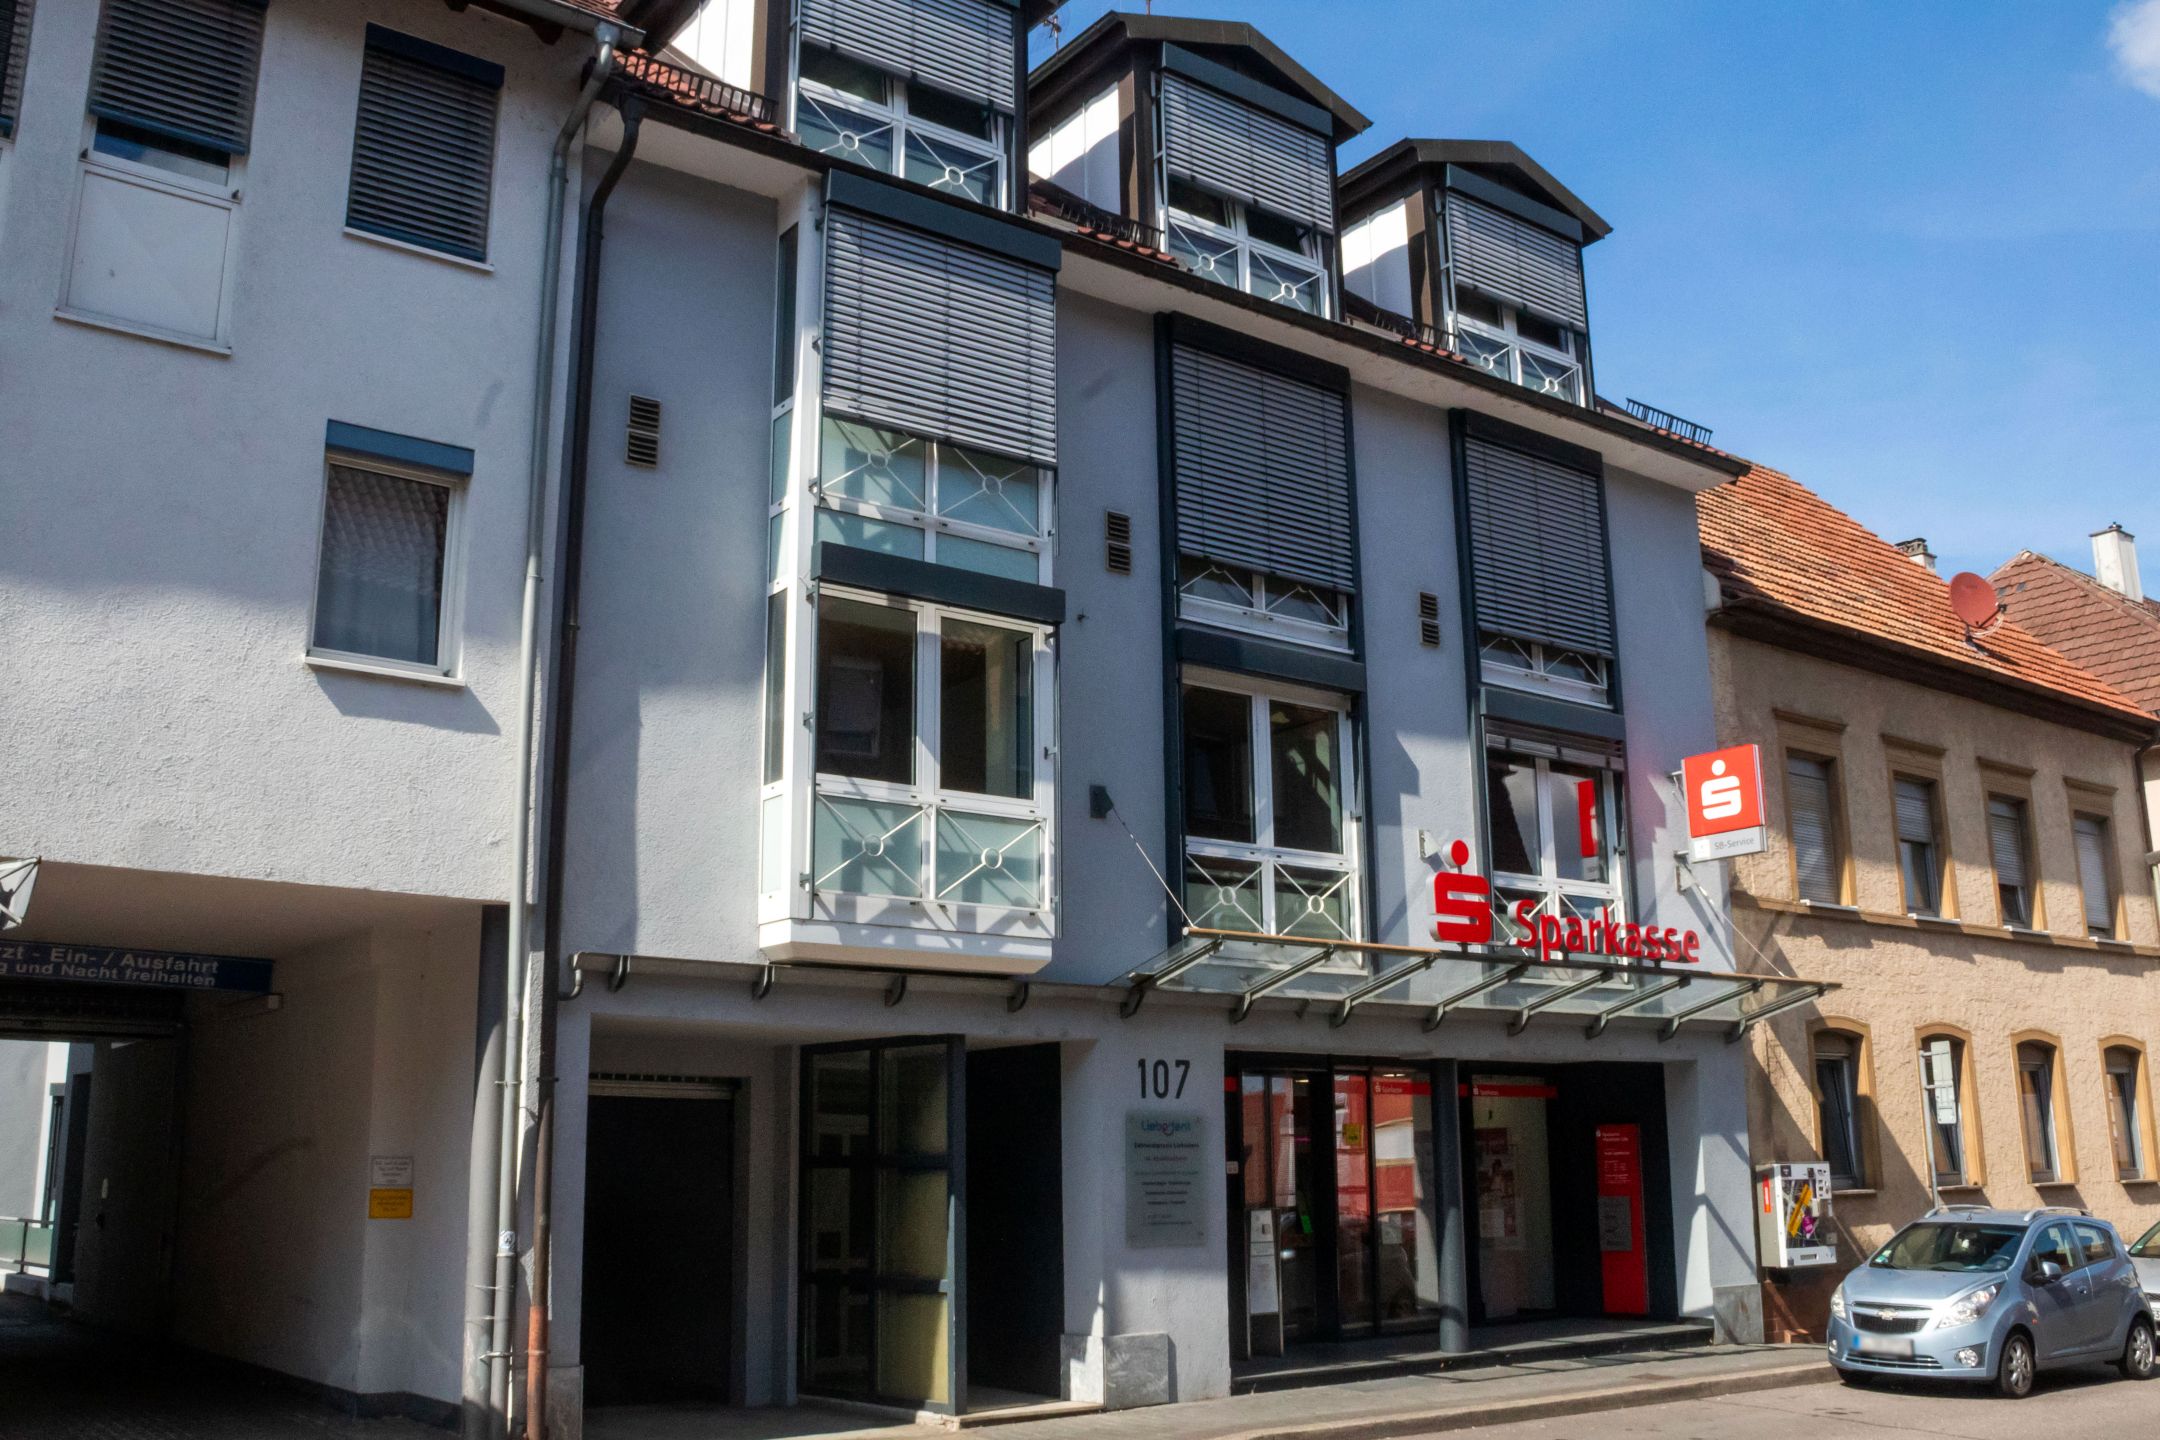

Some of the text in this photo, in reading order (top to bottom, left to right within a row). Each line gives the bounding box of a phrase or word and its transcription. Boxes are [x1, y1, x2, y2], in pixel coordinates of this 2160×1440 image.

[1714, 836, 1755, 850] SB-Service
[1508, 898, 1700, 963] Sparkasse
[50, 948, 97, 964] Ein-
[120, 953, 219, 974] Ausfahrt
[16, 963, 54, 975] und
[61, 966, 120, 979] Nacht
[125, 968, 216, 987] freihalten
[1138, 1058, 1190, 1099] 107
